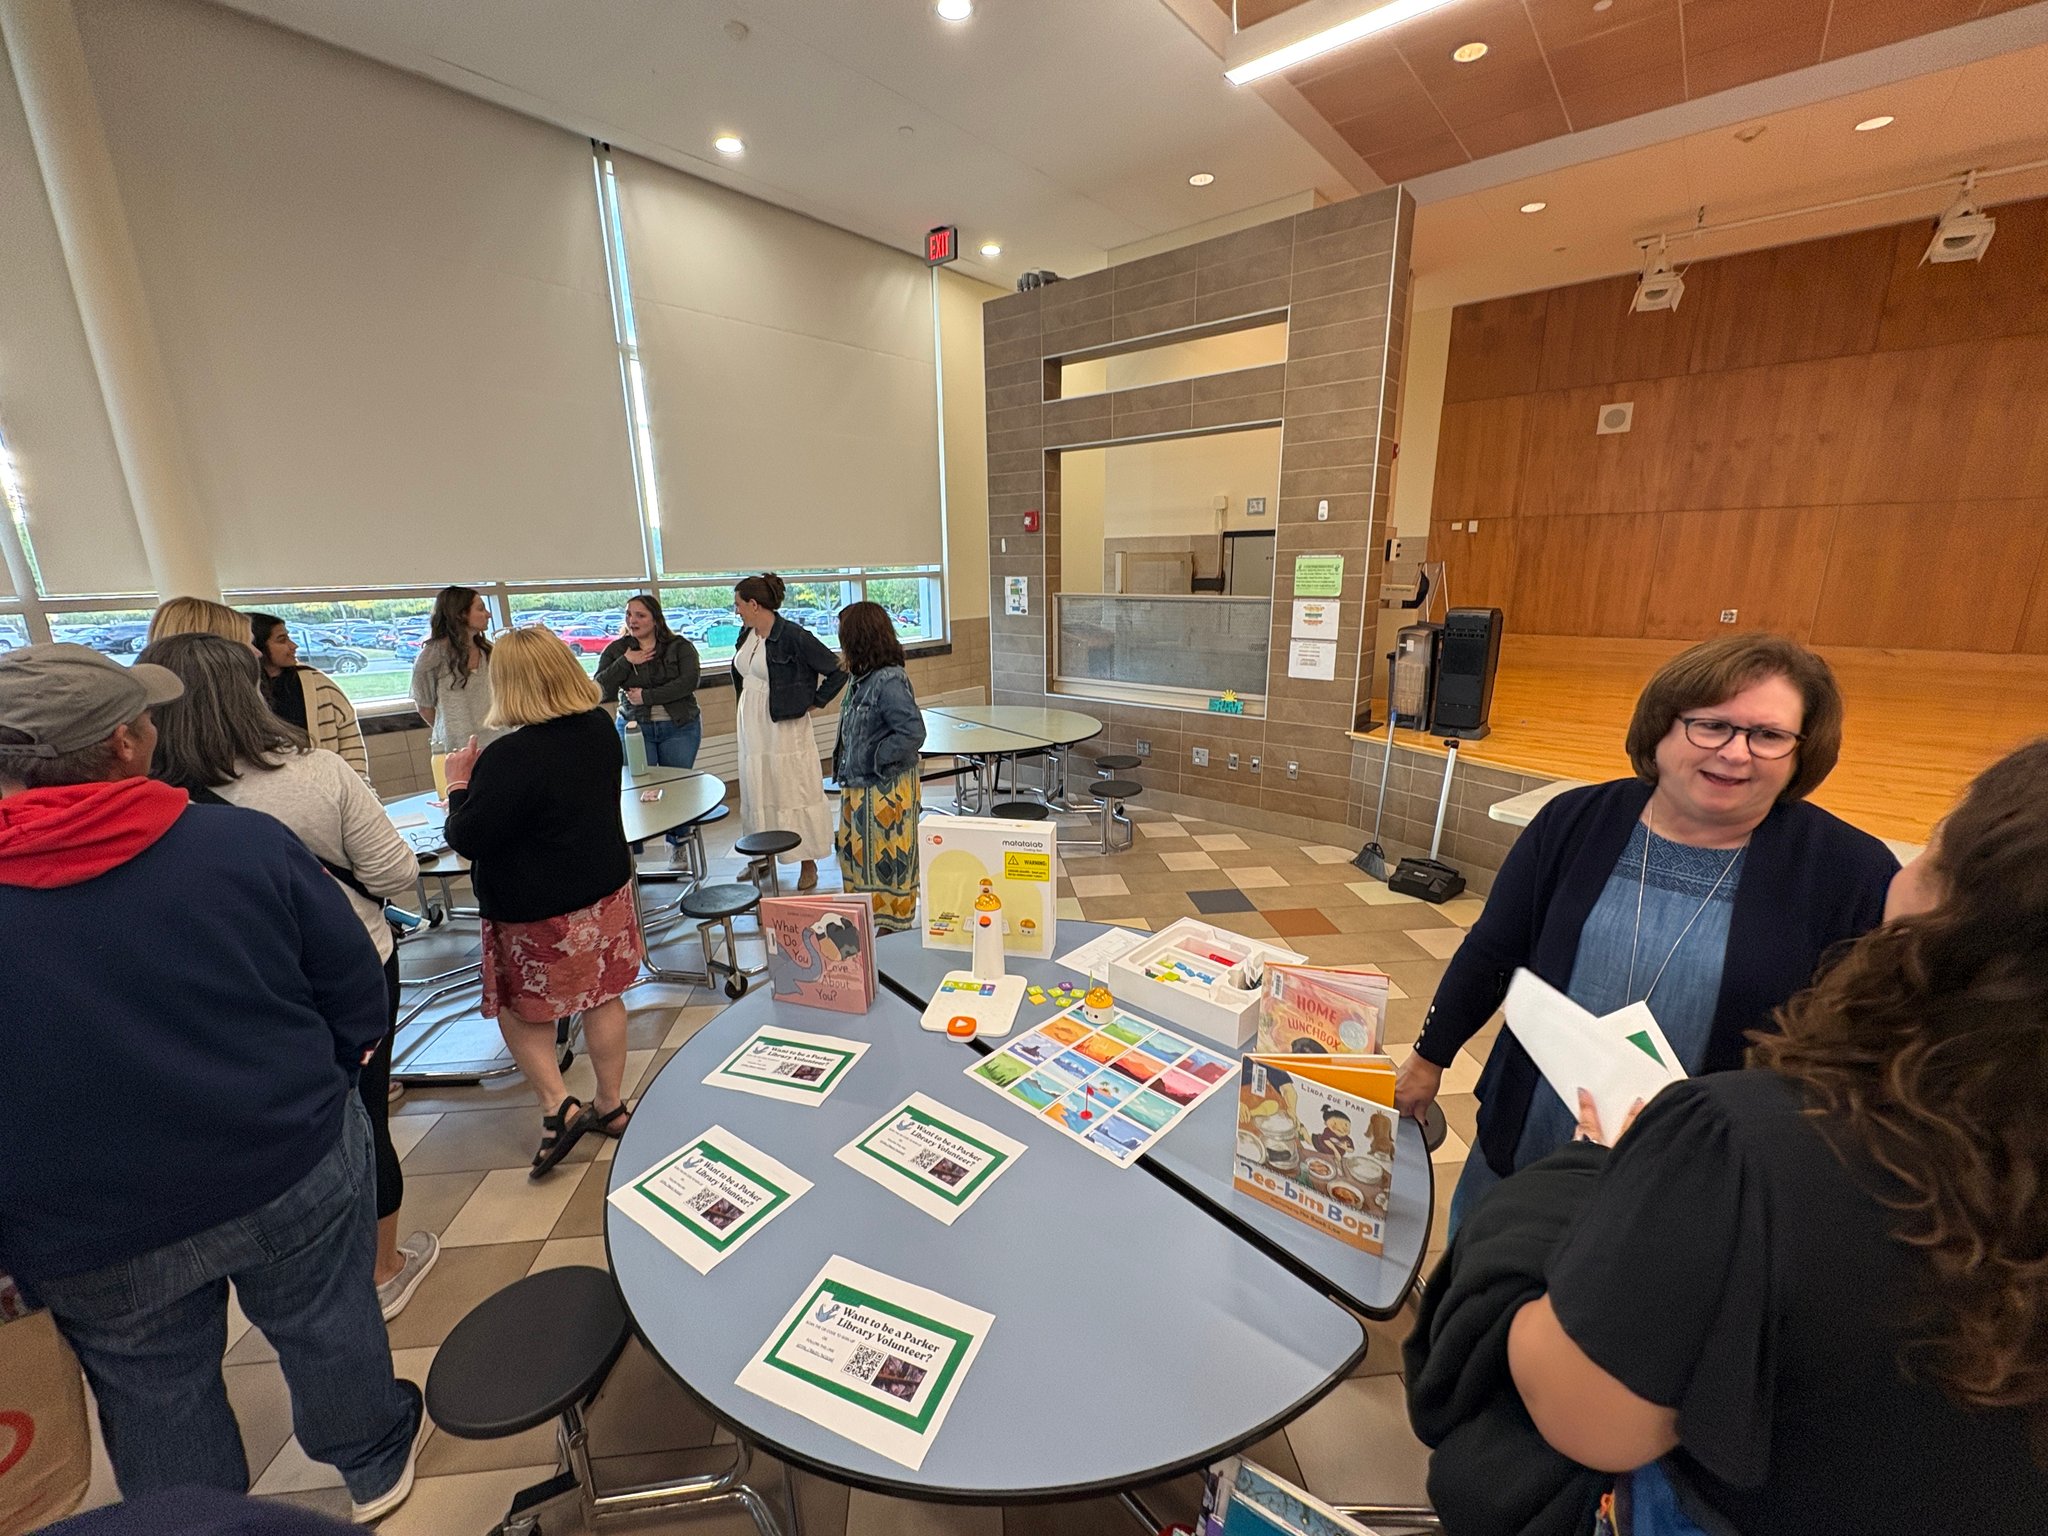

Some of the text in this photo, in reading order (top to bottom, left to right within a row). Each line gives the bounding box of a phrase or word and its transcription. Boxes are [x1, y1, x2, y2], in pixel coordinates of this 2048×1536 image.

[929, 231, 950, 261] EXIT
[1002, 840, 1043, 848] matatalab
[772, 918, 799, 934] What
[783, 934, 797, 947] Do
[792, 949, 809, 964] You
[824, 960, 849, 973] Love
[815, 988, 837, 1001] You?
[821, 974, 850, 990] About
[1297, 995, 1337, 1025] HOME
[1305, 1013, 1314, 1023] in
[1288, 1018, 1341, 1051] LUNCHBOX
[767, 1051, 830, 1066] Library Volunteer?
[911, 1130, 937, 1147] Library
[937, 1143, 976, 1167] Volunteer?
[916, 1124, 935, 1138] Want
[942, 1138, 952, 1146] be
[956, 1145, 983, 1162] Parker
[696, 1167, 720, 1186] Library
[719, 1181, 754, 1208] Volunteer?
[704, 1161, 721, 1175] Want
[719, 1172, 728, 1180] to
[726, 1176, 735, 1184] be
[738, 1184, 763, 1202] Parker
[1327, 1203, 1380, 1239] Bop!
[836, 1317, 933, 1363] Library Volunteer?
[843, 1306, 940, 1353] Want to be a Parker
